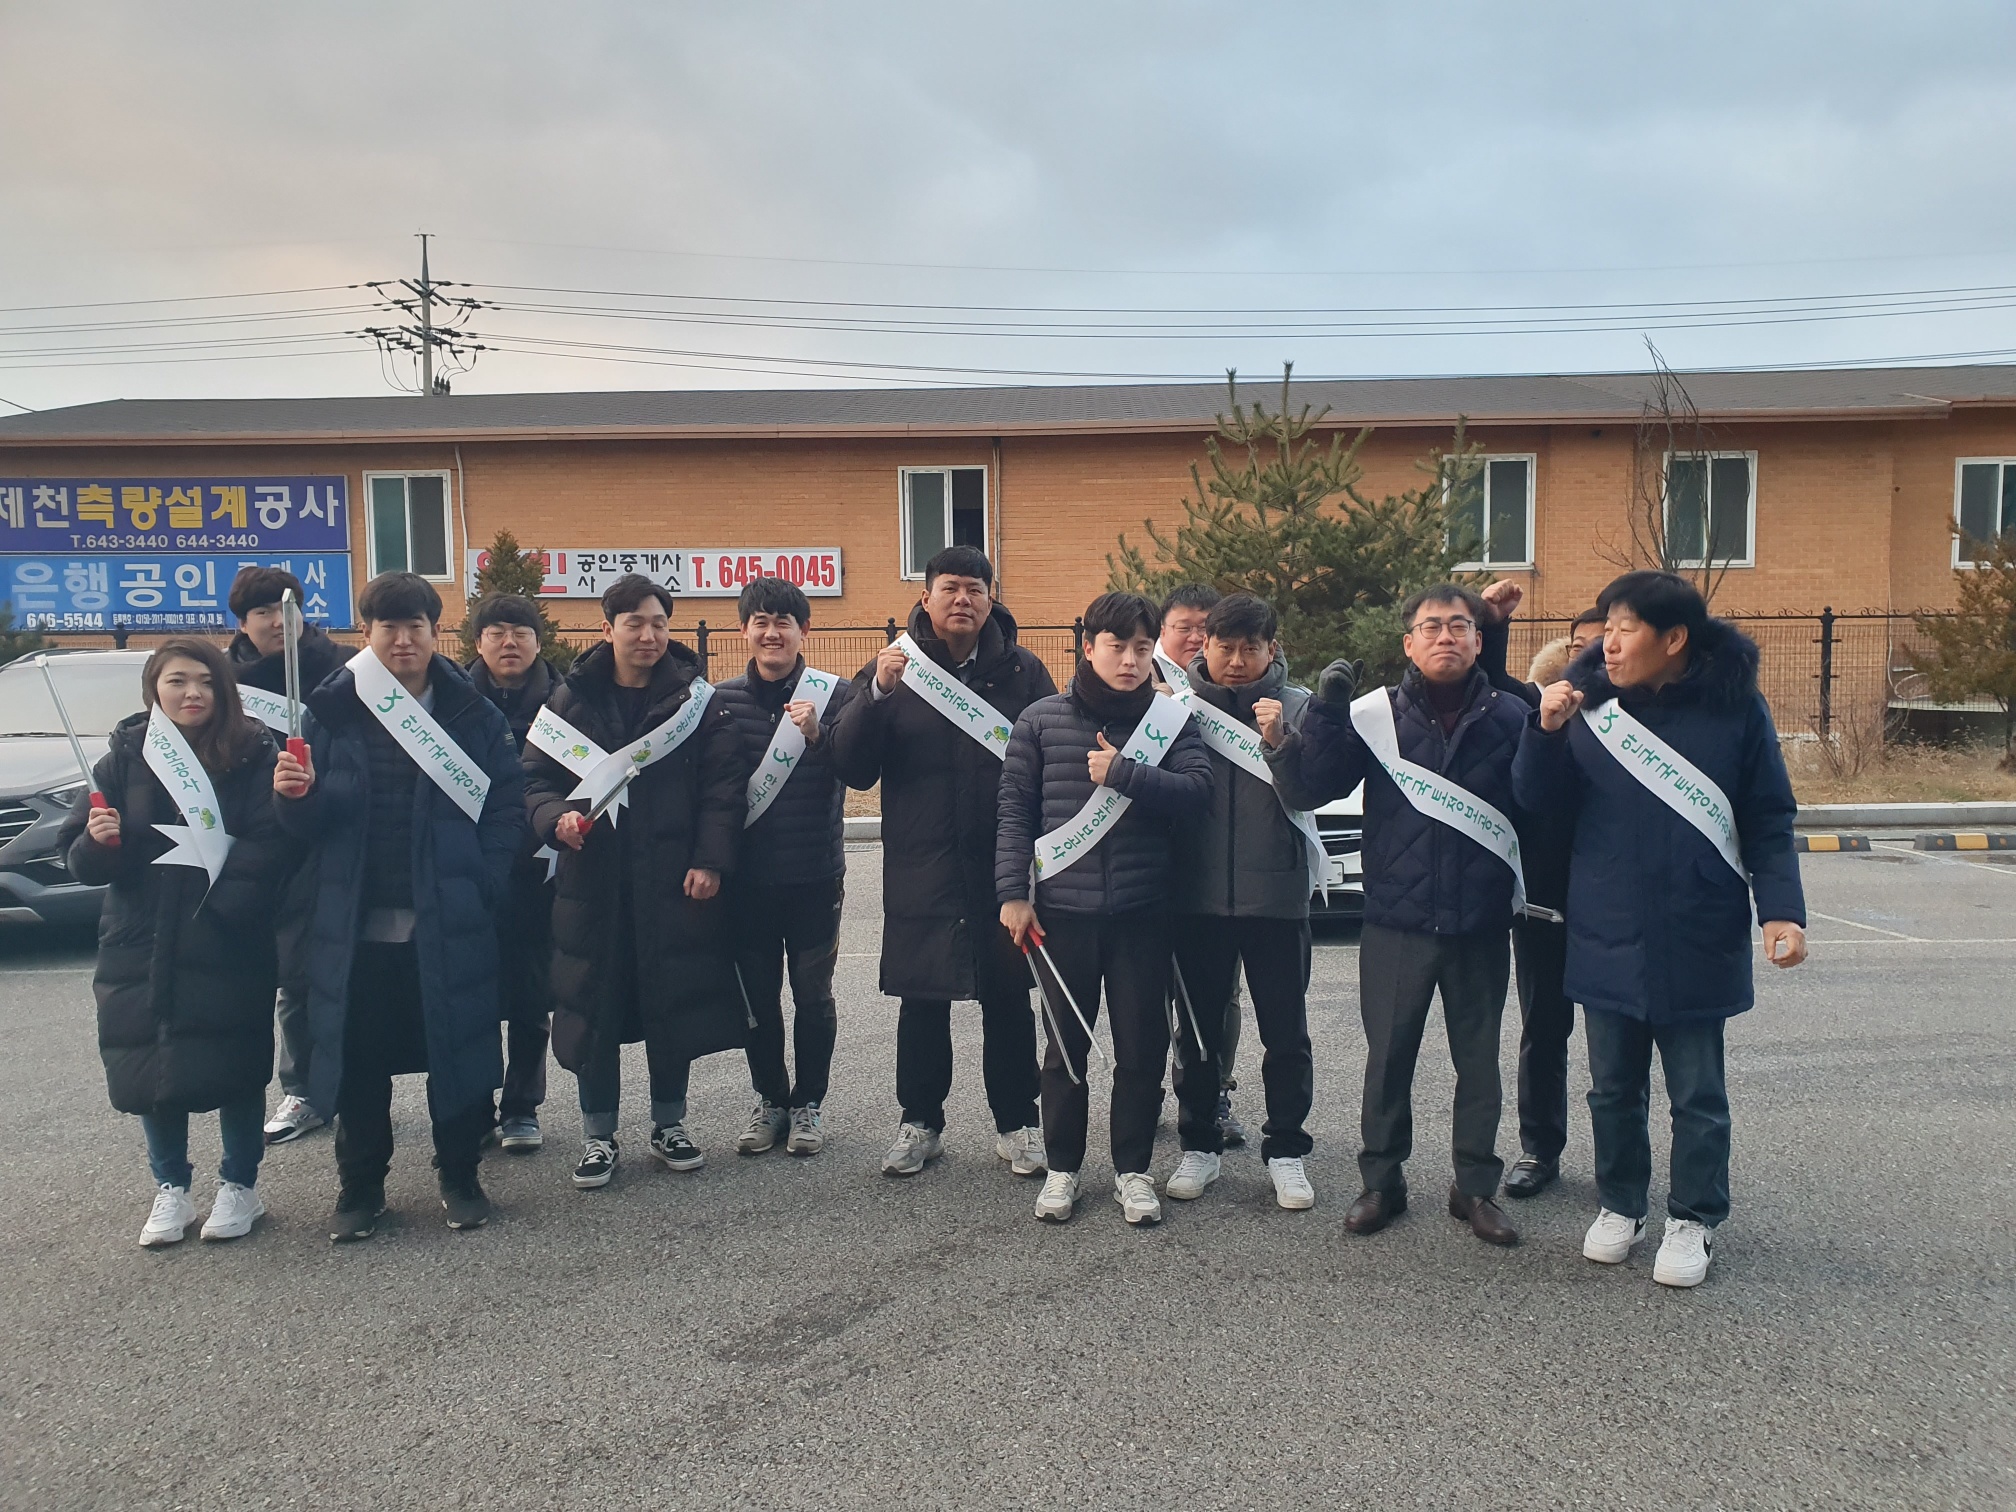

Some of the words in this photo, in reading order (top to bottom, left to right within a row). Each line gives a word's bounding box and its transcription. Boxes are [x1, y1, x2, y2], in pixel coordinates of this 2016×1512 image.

[70, 534, 168, 548] T.643-3440
[176, 534, 259, 548] 644-3440
[577, 553, 682, 573] 공인중개사
